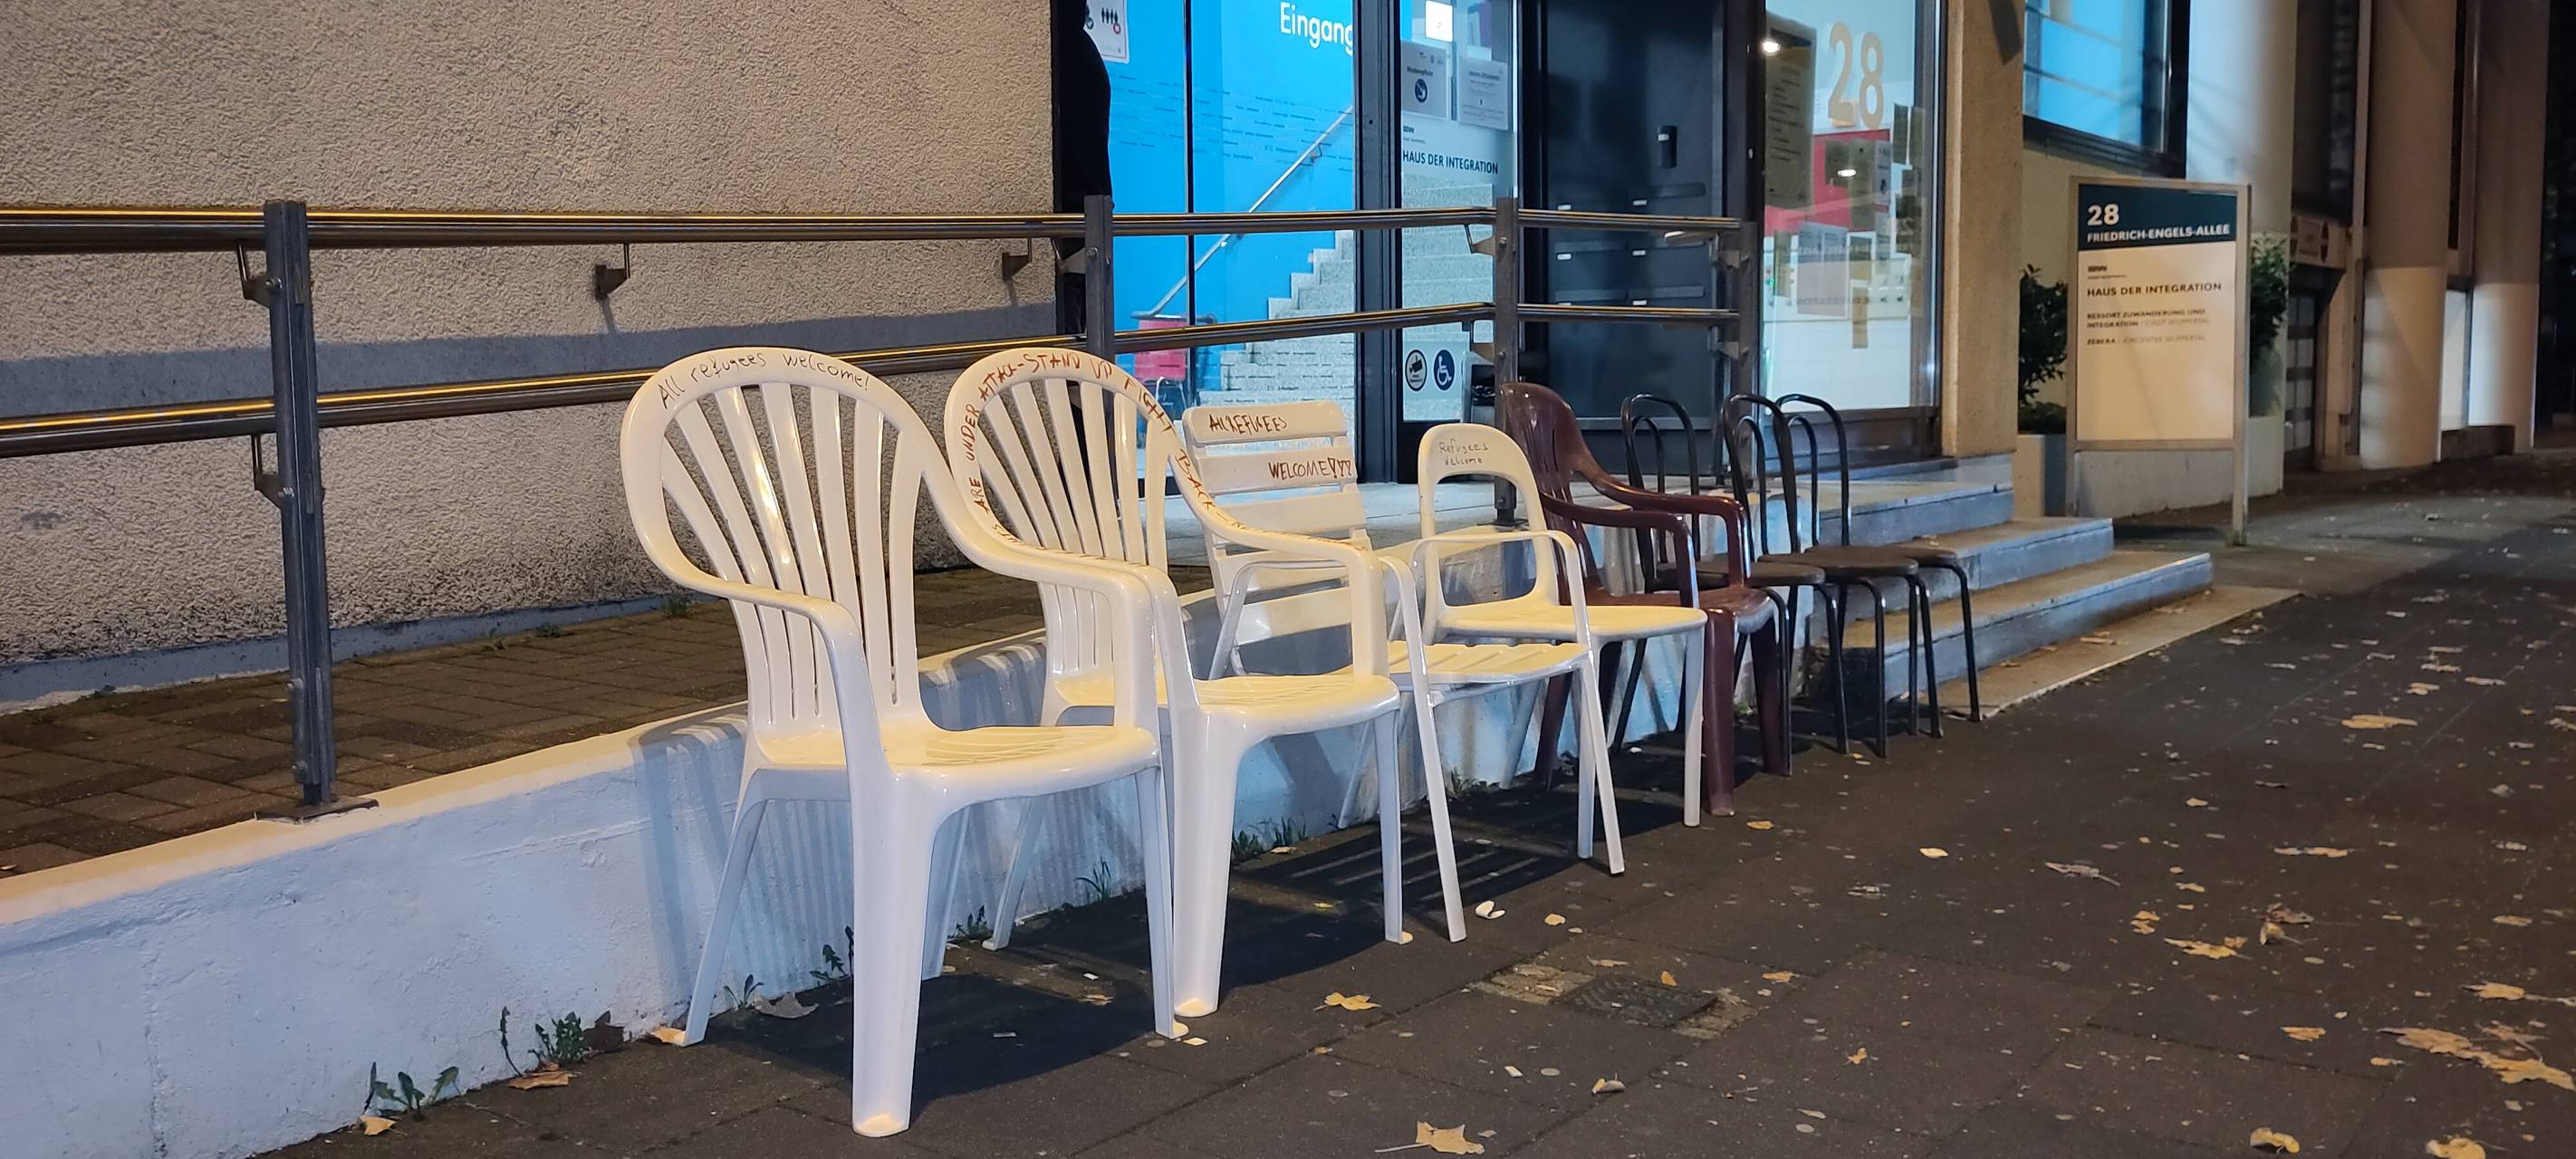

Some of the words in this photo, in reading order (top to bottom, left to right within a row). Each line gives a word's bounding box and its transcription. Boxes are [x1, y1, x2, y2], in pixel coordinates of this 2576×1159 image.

[1280, 1, 1353, 57] Eingang
[1828, 22, 1884, 129] 28
[1403, 149, 1426, 164] HAUS
[1428, 153, 1444, 168] DER
[1446, 155, 1499, 174] INTEGRATION
[2087, 204, 2119, 225] 28
[2087, 224, 2230, 243] FRIEDRICH-ENGELS-ALLEE
[2087, 287, 2117, 297] HAUS
[2120, 285, 2143, 295] DER
[2146, 283, 2222, 294] INTEGRATION
[2087, 321, 2139, 329] INTEGRATION
[658, 375, 686, 409] All
[690, 351, 767, 383] refugees
[782, 352, 870, 391] welcome!
[960, 404, 981, 462] UNDER
[969, 476, 990, 514] ARE
